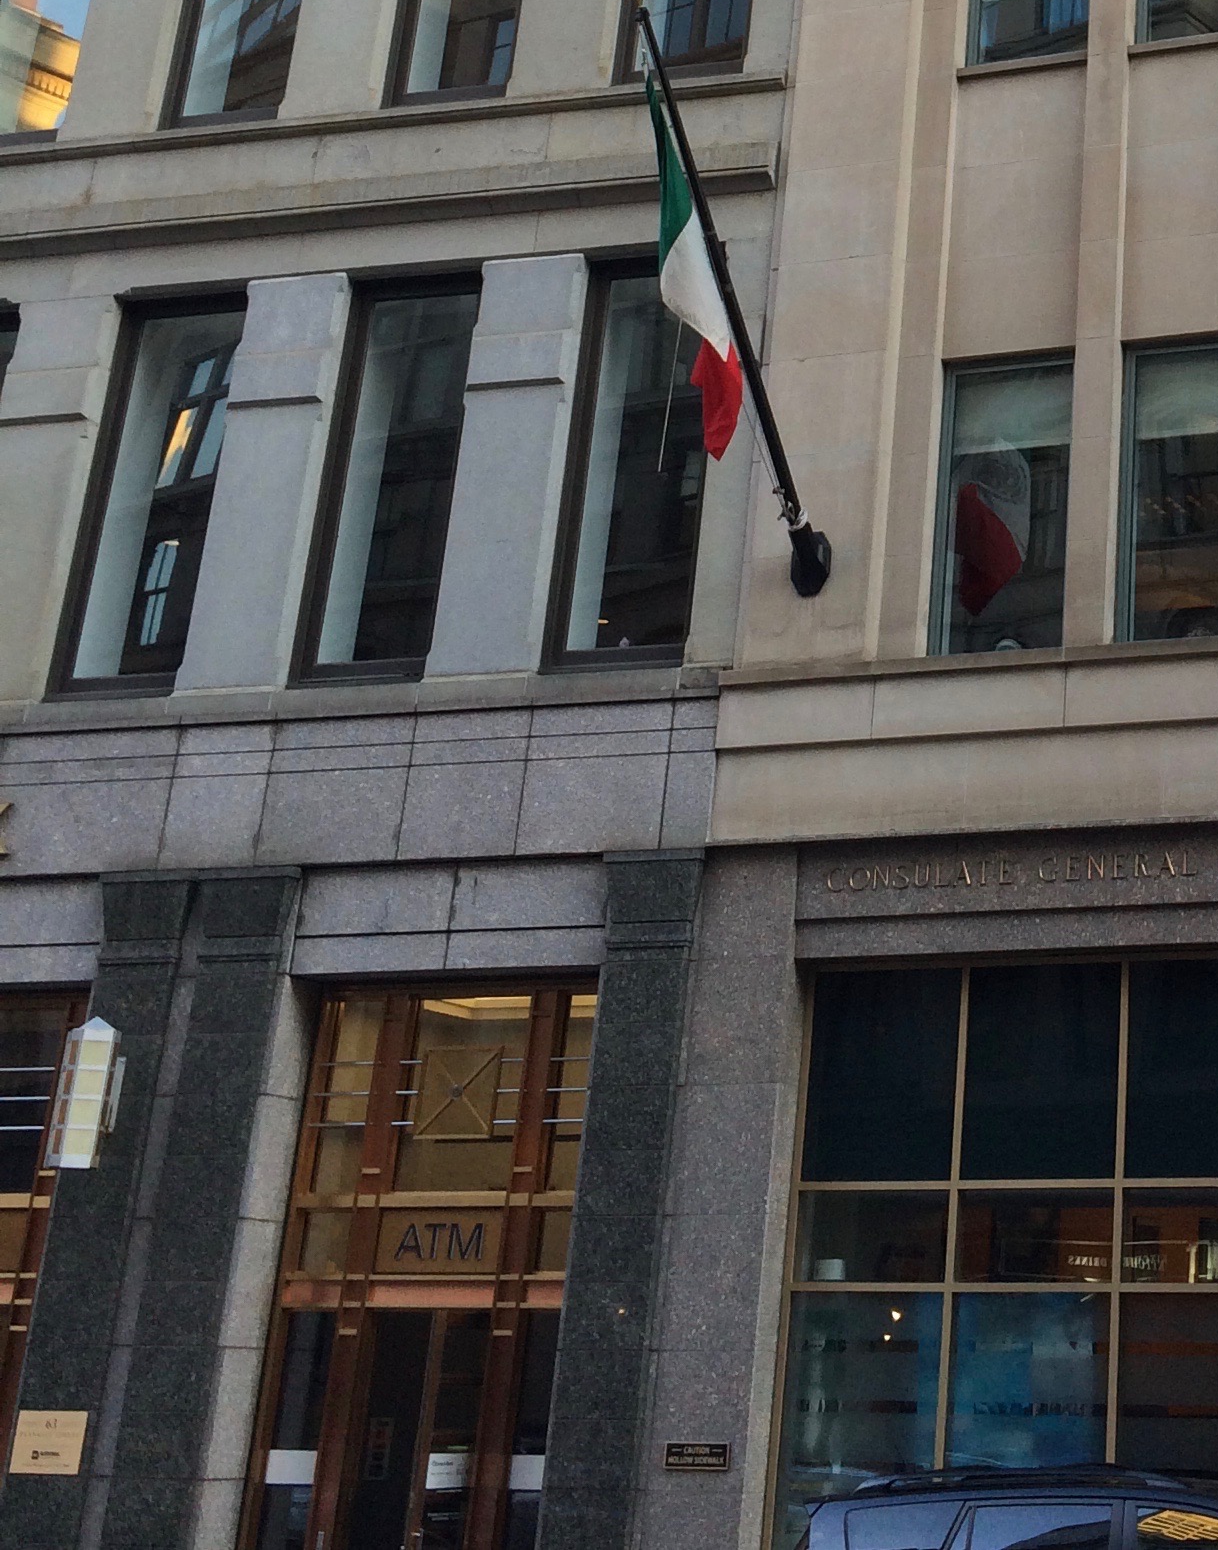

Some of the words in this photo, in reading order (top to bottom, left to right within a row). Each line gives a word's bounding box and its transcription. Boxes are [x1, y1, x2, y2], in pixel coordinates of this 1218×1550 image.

[826, 860, 1013, 893] CONSULATE
[1038, 850, 1198, 882] GENERAL
[393, 1222, 485, 1262] ATM
